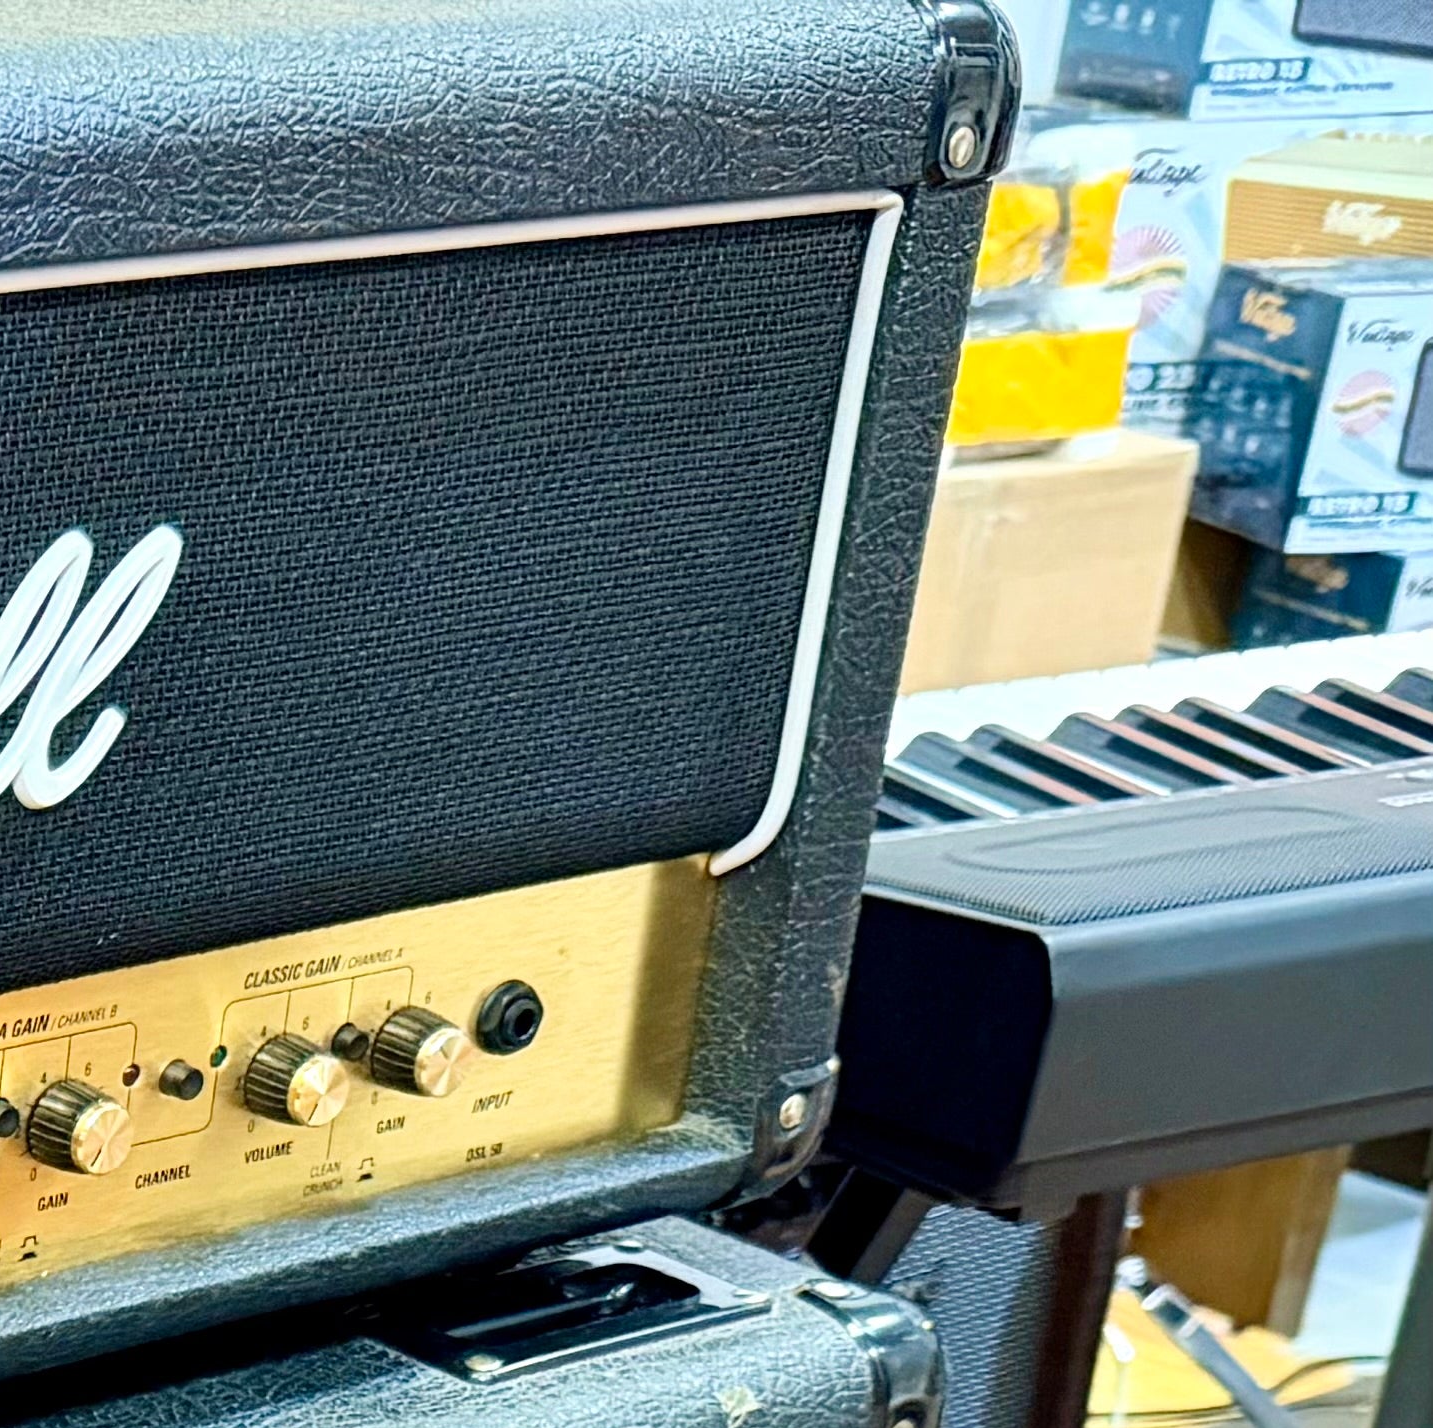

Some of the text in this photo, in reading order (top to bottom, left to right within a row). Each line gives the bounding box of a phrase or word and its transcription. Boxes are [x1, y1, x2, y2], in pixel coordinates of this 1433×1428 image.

[244, 962, 303, 990] CLASSIC
[305, 955, 342, 978] GAIN
[424, 991, 432, 1005] 6
[11, 1014, 50, 1038] GAIN
[109, 1004, 118, 1018] B
[302, 1016, 310, 1031] 6
[40, 1072, 47, 1084] 4
[84, 1062, 92, 1077] 6
[471, 1090, 514, 1114] INPUT
[247, 1119, 255, 1133] 0
[376, 1116, 406, 1135] GAIN
[244, 1140, 294, 1165] VOLUME
[30, 1167, 37, 1182] 0
[135, 1164, 191, 1190] CHANNEL
[310, 1162, 342, 1179] CLEAN
[303, 1177, 344, 1197] CRUNCH
[37, 1192, 69, 1212] GAIN
